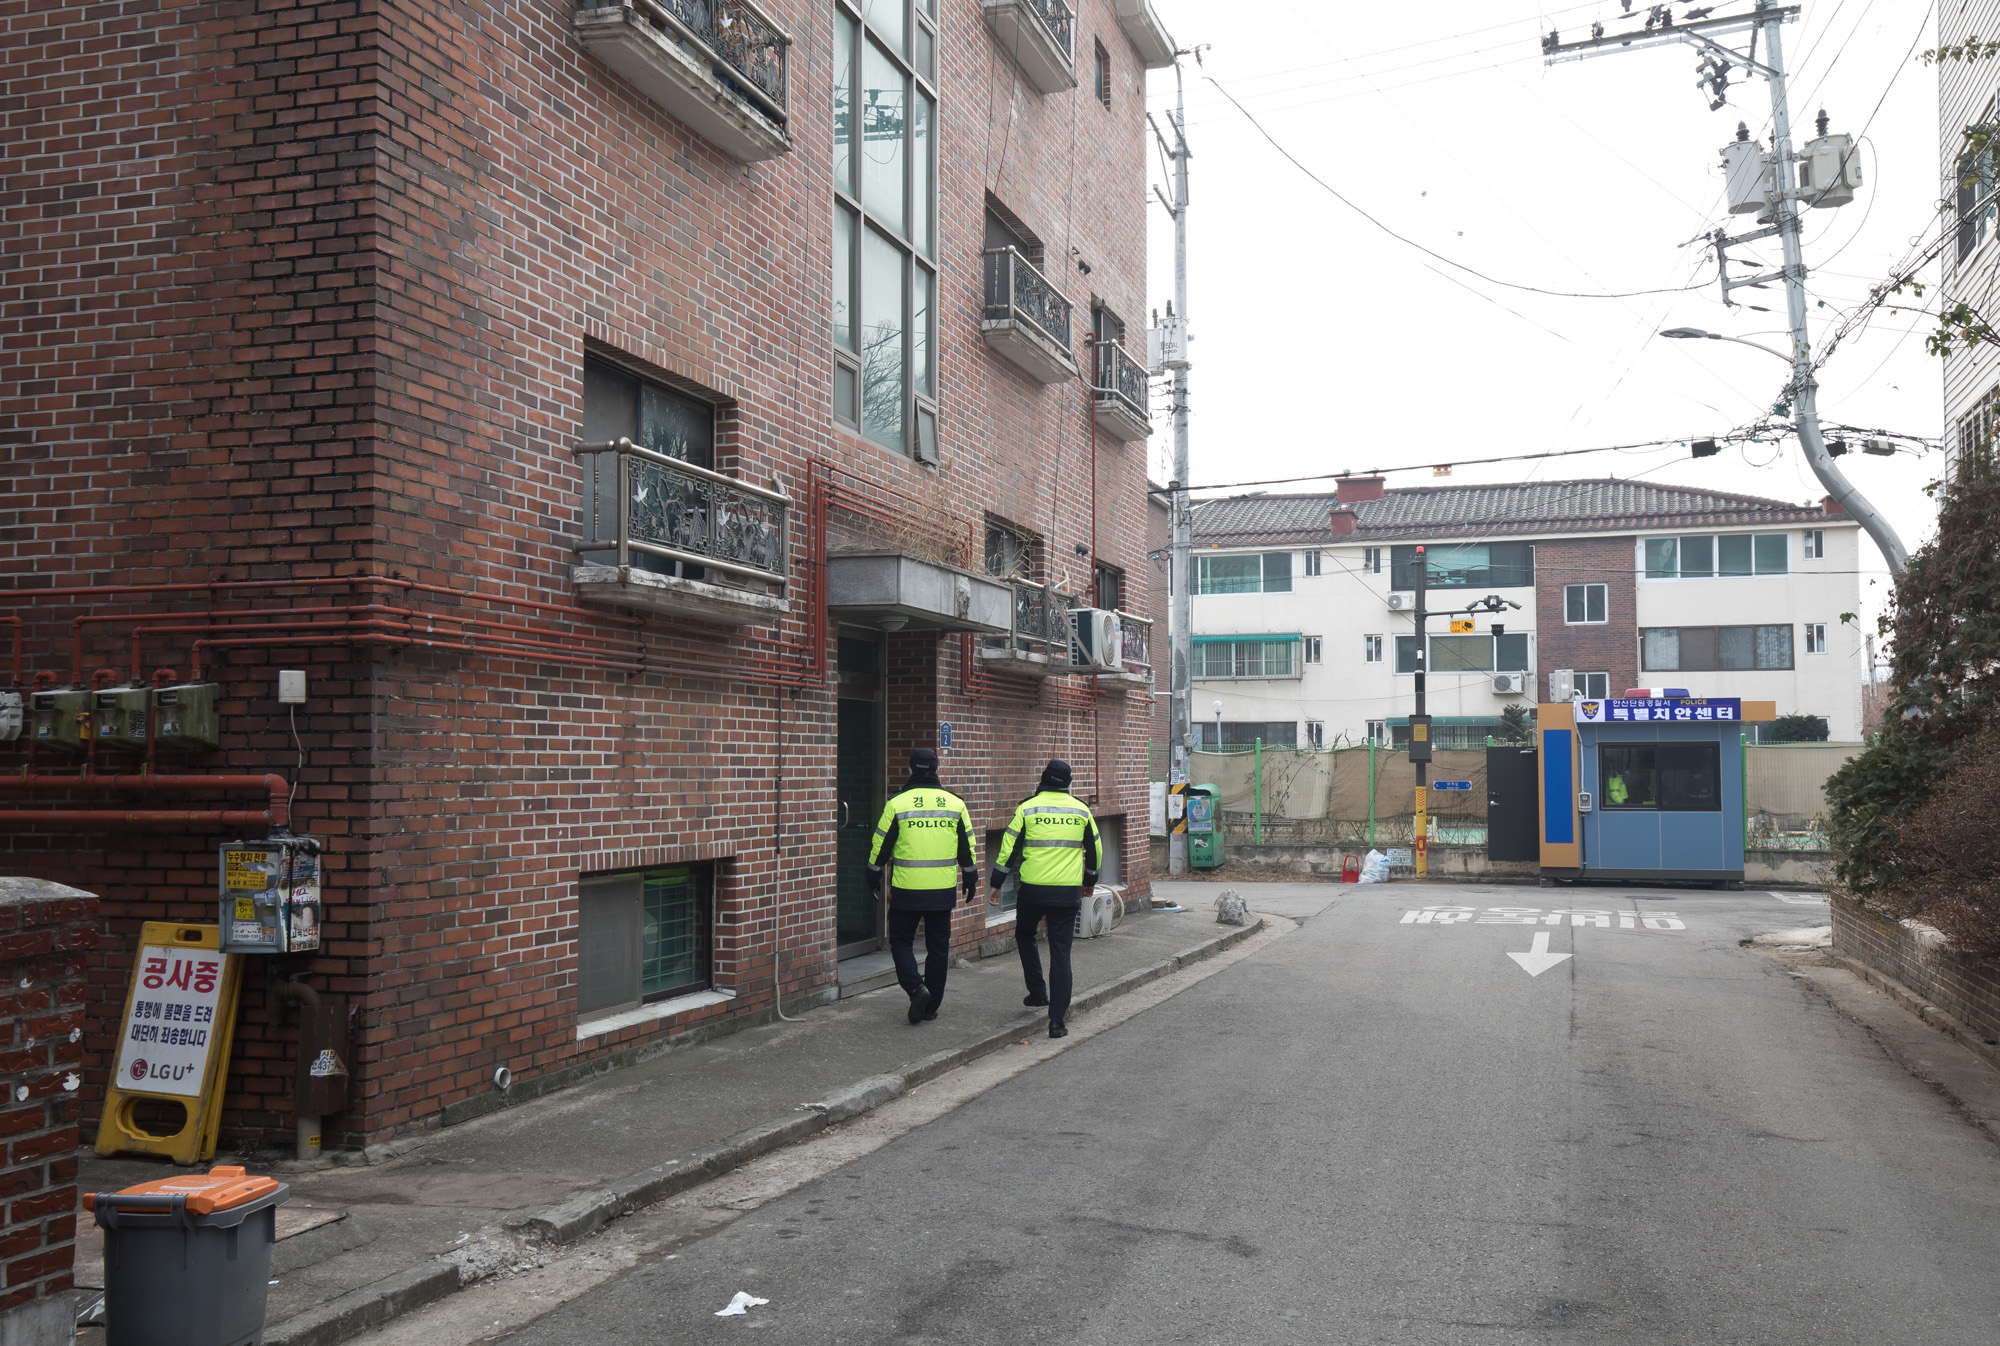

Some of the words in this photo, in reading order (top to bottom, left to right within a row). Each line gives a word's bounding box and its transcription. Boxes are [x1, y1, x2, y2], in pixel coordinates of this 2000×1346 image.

[1612, 699, 1671, 707] 안산단원경찰서
[1680, 698, 1708, 706] POLICE
[1613, 706, 1734, 721] 특별치안센터
[943, 734, 949, 745] 2
[907, 819, 955, 828] POLICE
[1034, 816, 1082, 826] POLICE
[254, 853, 267, 863] 전문
[1398, 905, 1687, 930] 일방통행
[143, 957, 219, 994] 공사중
[134, 1000, 163, 1019] 통행에
[163, 1003, 193, 1022] 불편을
[193, 1006, 214, 1024] 드려
[130, 1024, 159, 1044] 대단히
[160, 1027, 207, 1047] 죄송합니다
